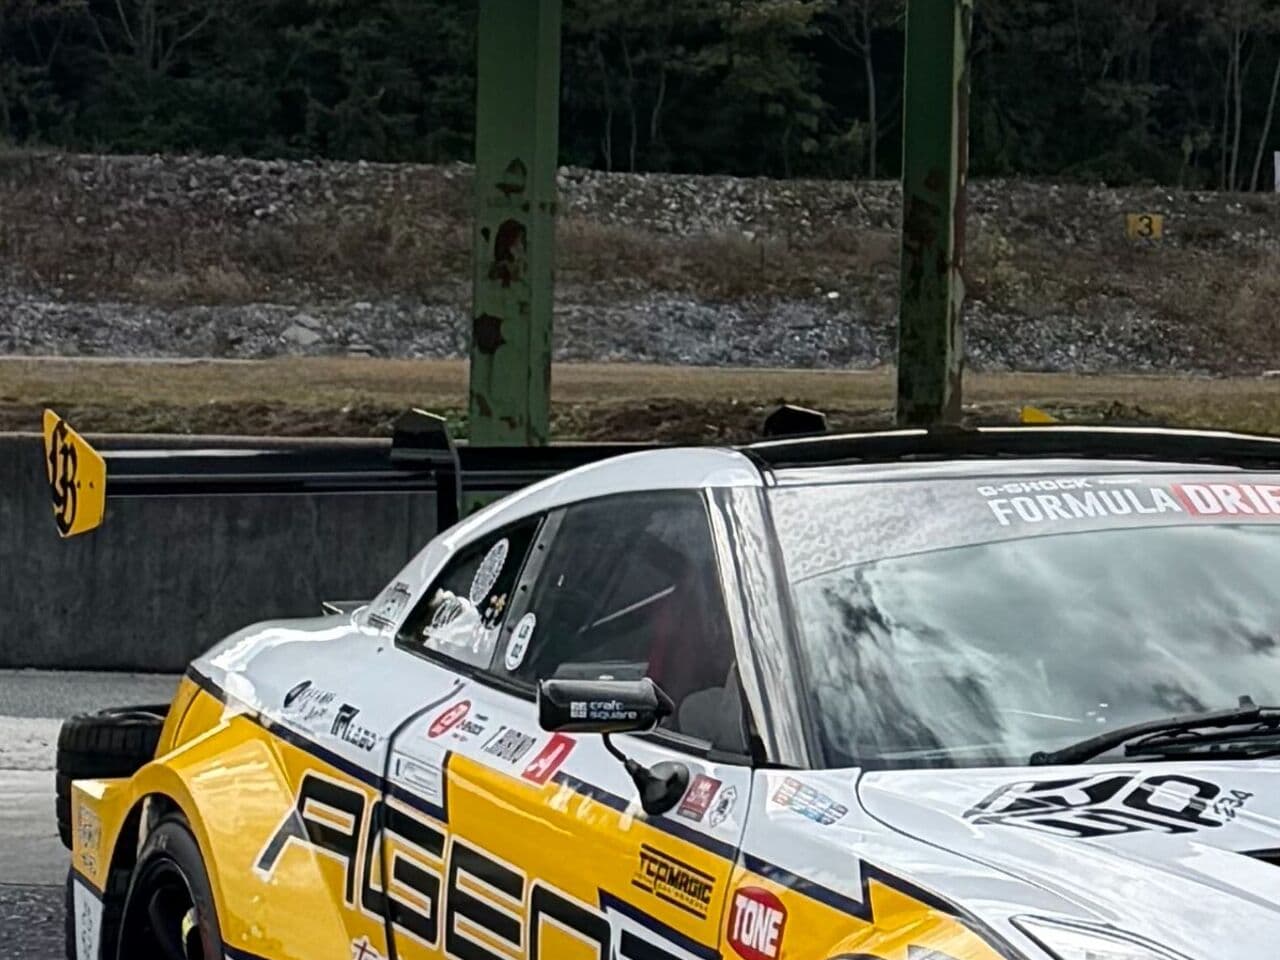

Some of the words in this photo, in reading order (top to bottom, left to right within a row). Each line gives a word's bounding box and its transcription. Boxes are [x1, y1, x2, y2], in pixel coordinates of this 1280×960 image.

[1138, 215, 1154, 237] 3
[987, 487, 1182, 526] FORMULA
[732, 895, 785, 958] TONE
